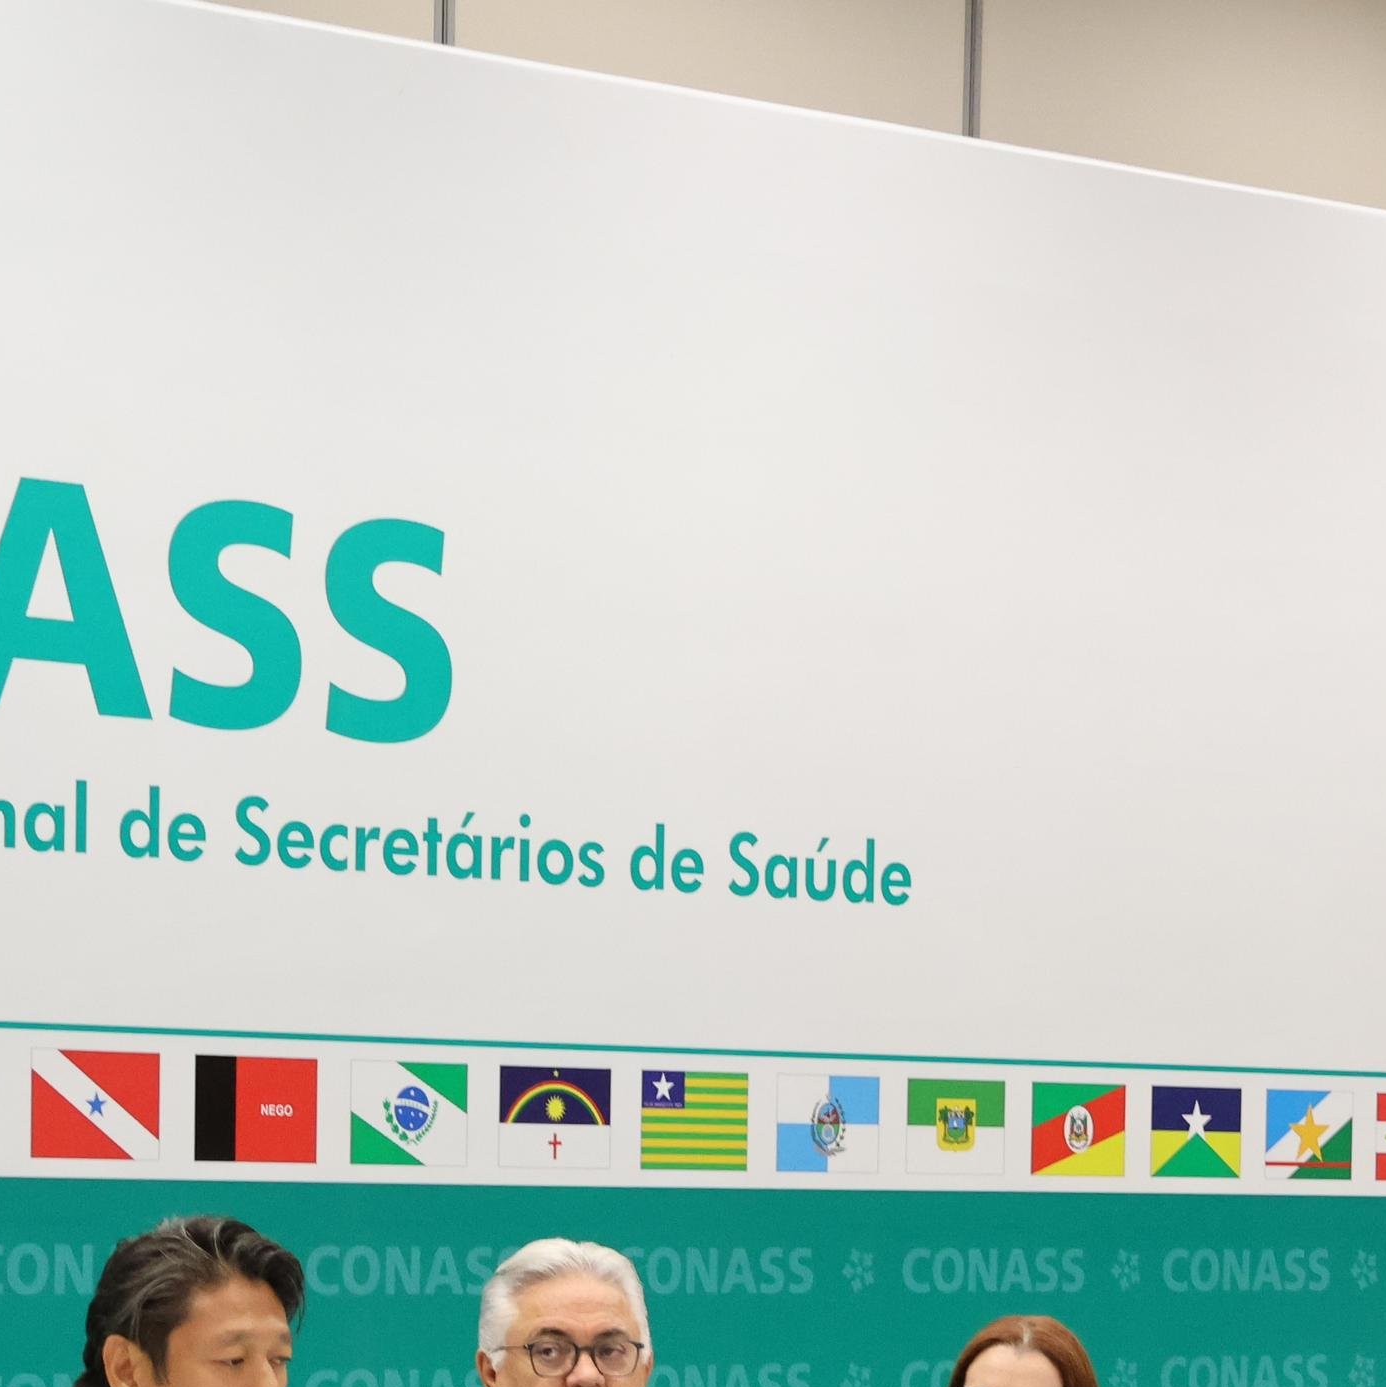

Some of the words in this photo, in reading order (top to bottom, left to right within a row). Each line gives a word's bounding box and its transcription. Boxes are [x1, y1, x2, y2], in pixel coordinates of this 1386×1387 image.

[119, 785, 207, 862] de
[235, 795, 605, 888] Secretários
[630, 823, 705, 894] de
[728, 831, 912, 906] Saúde
[260, 1104, 293, 1117] NEGO
[305, 1246, 516, 1296] CONAS
[622, 1246, 813, 1295] ONASS
[902, 1247, 1085, 1294] CONASS
[1163, 1248, 1330, 1293] CONASS
